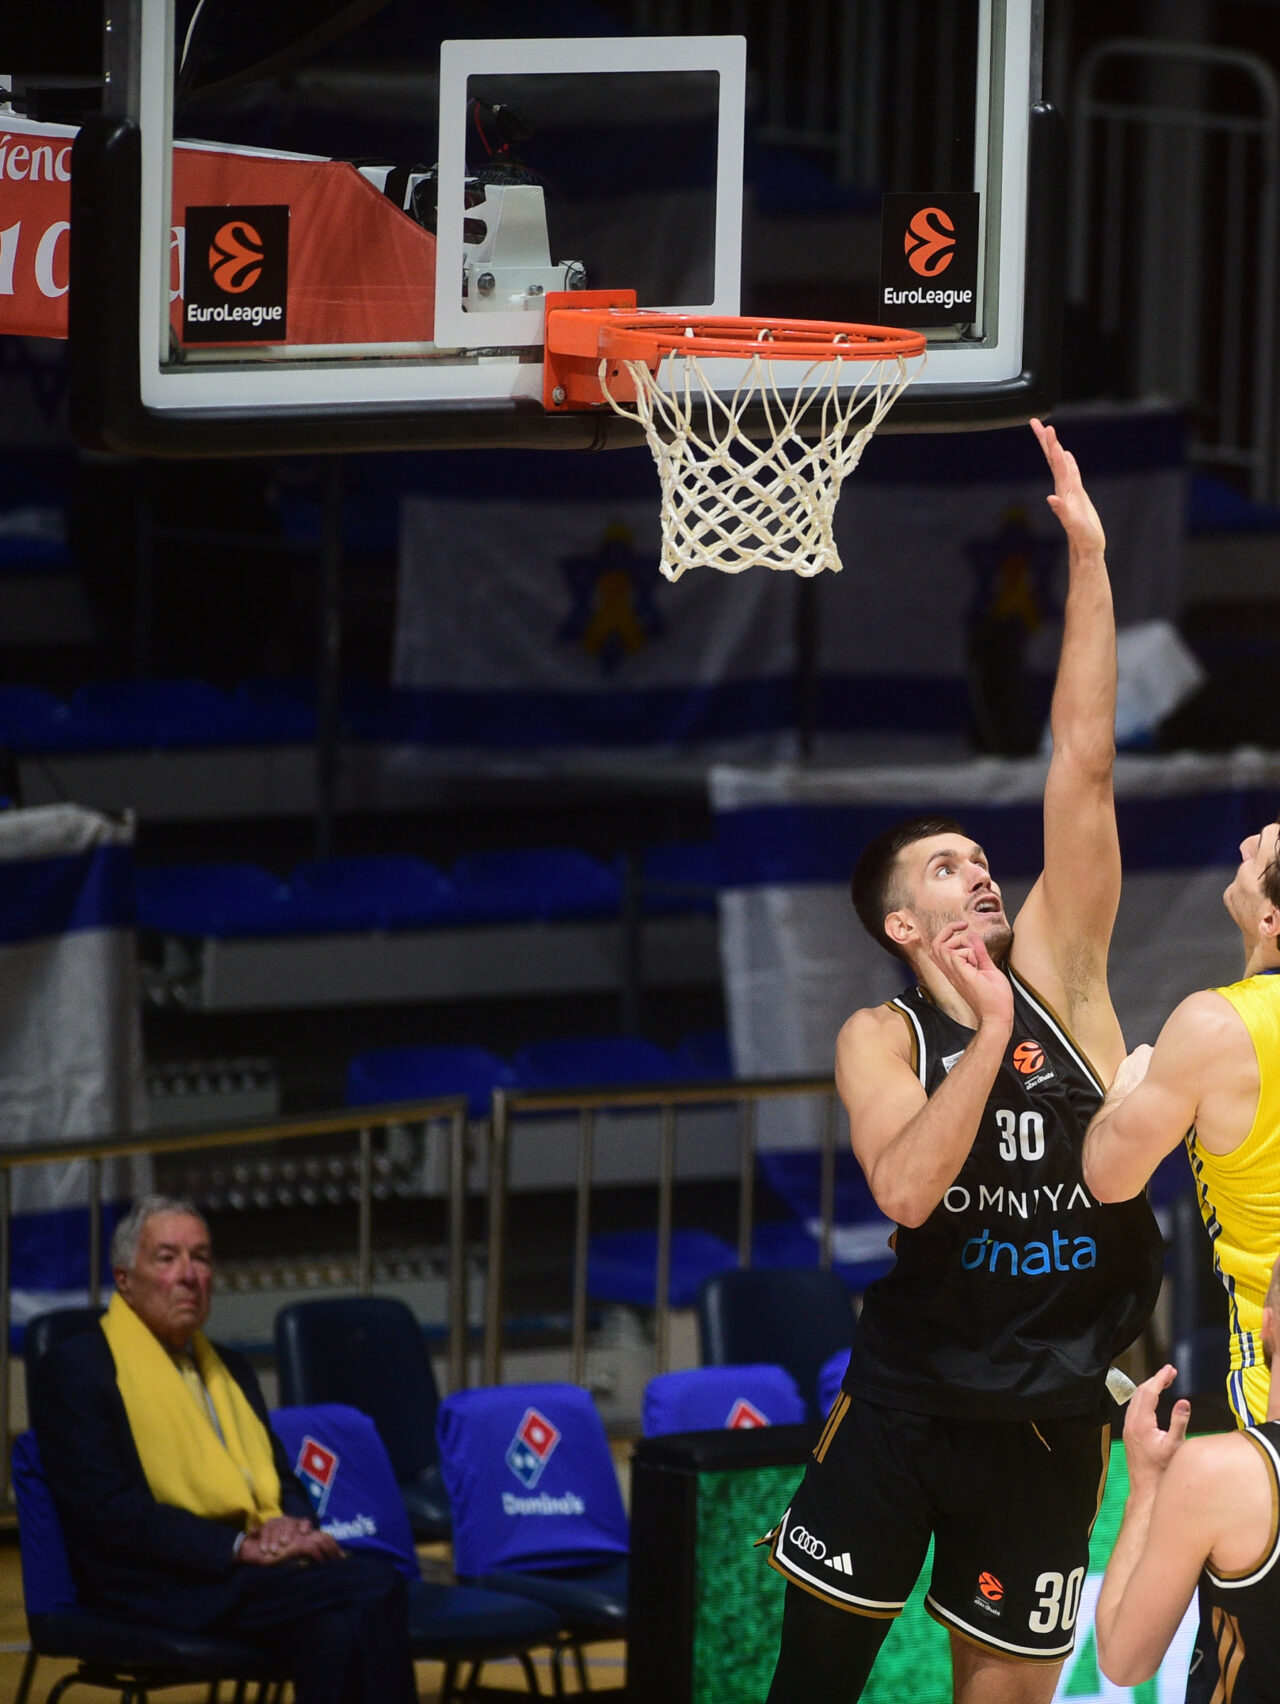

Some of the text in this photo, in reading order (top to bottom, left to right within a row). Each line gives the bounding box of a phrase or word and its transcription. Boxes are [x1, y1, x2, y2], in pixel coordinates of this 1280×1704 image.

[187, 304, 283, 326] EuroLeague
[884, 287, 972, 309] EuroLeague
[996, 1109, 1045, 1162] 30
[943, 1183, 1102, 1219] OMNIYA
[961, 1228, 1097, 1276] dnata
[1028, 1566, 1085, 1634] 30
